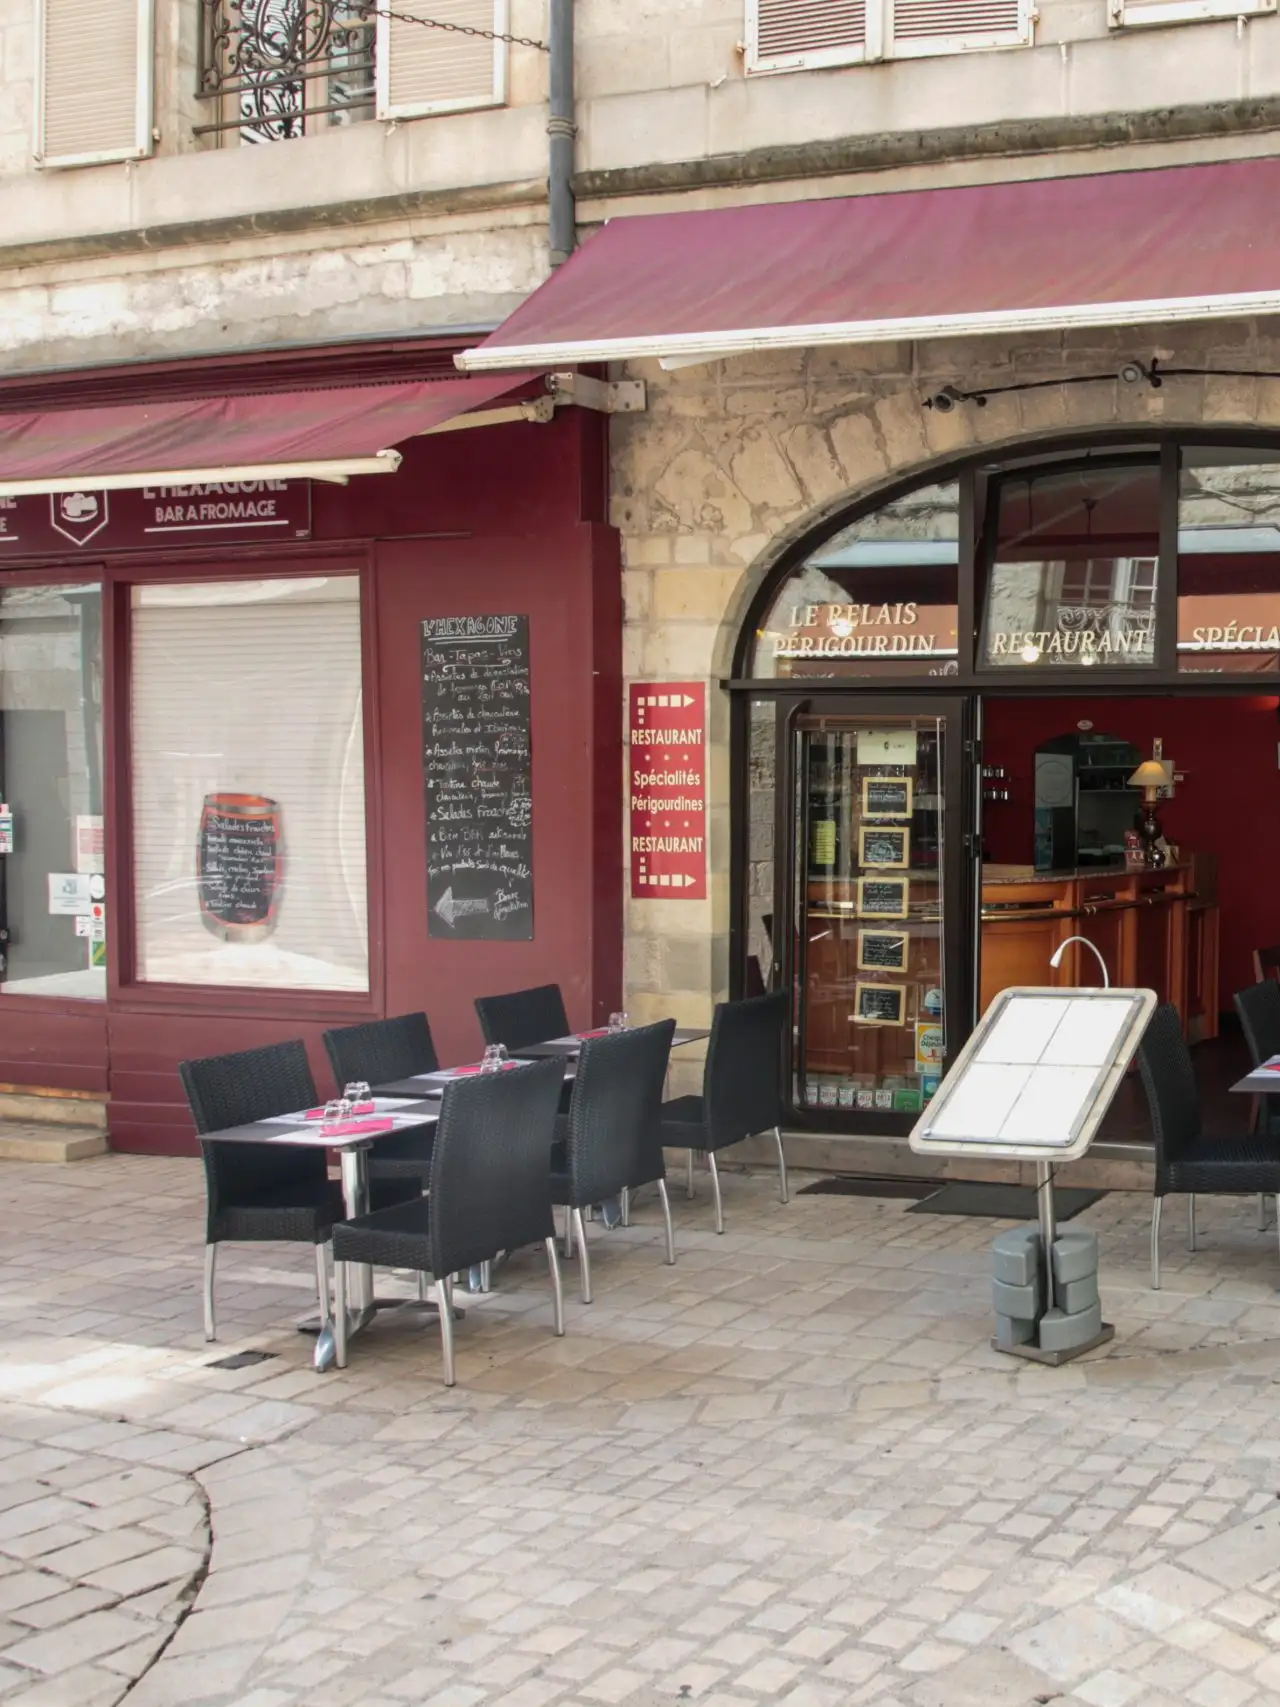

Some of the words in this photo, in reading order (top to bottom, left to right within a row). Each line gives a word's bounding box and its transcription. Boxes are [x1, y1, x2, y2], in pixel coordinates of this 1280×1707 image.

[155, 505, 184, 523] BAR
[186, 504, 199, 521] A
[199, 499, 277, 521] FROMAGE
[423, 615, 519, 637] L'HEXAGONE
[789, 605, 819, 628] LE
[827, 602, 918, 626] RELAIS
[773, 630, 936, 657] PÉRIGOURDIN
[991, 629, 1148, 655] RESTAURANT
[631, 728, 703, 746] RESTAURANT
[633, 768, 701, 789] Spécialités
[631, 794, 704, 814] Périgourdines
[632, 836, 704, 853] RESTAURANT
